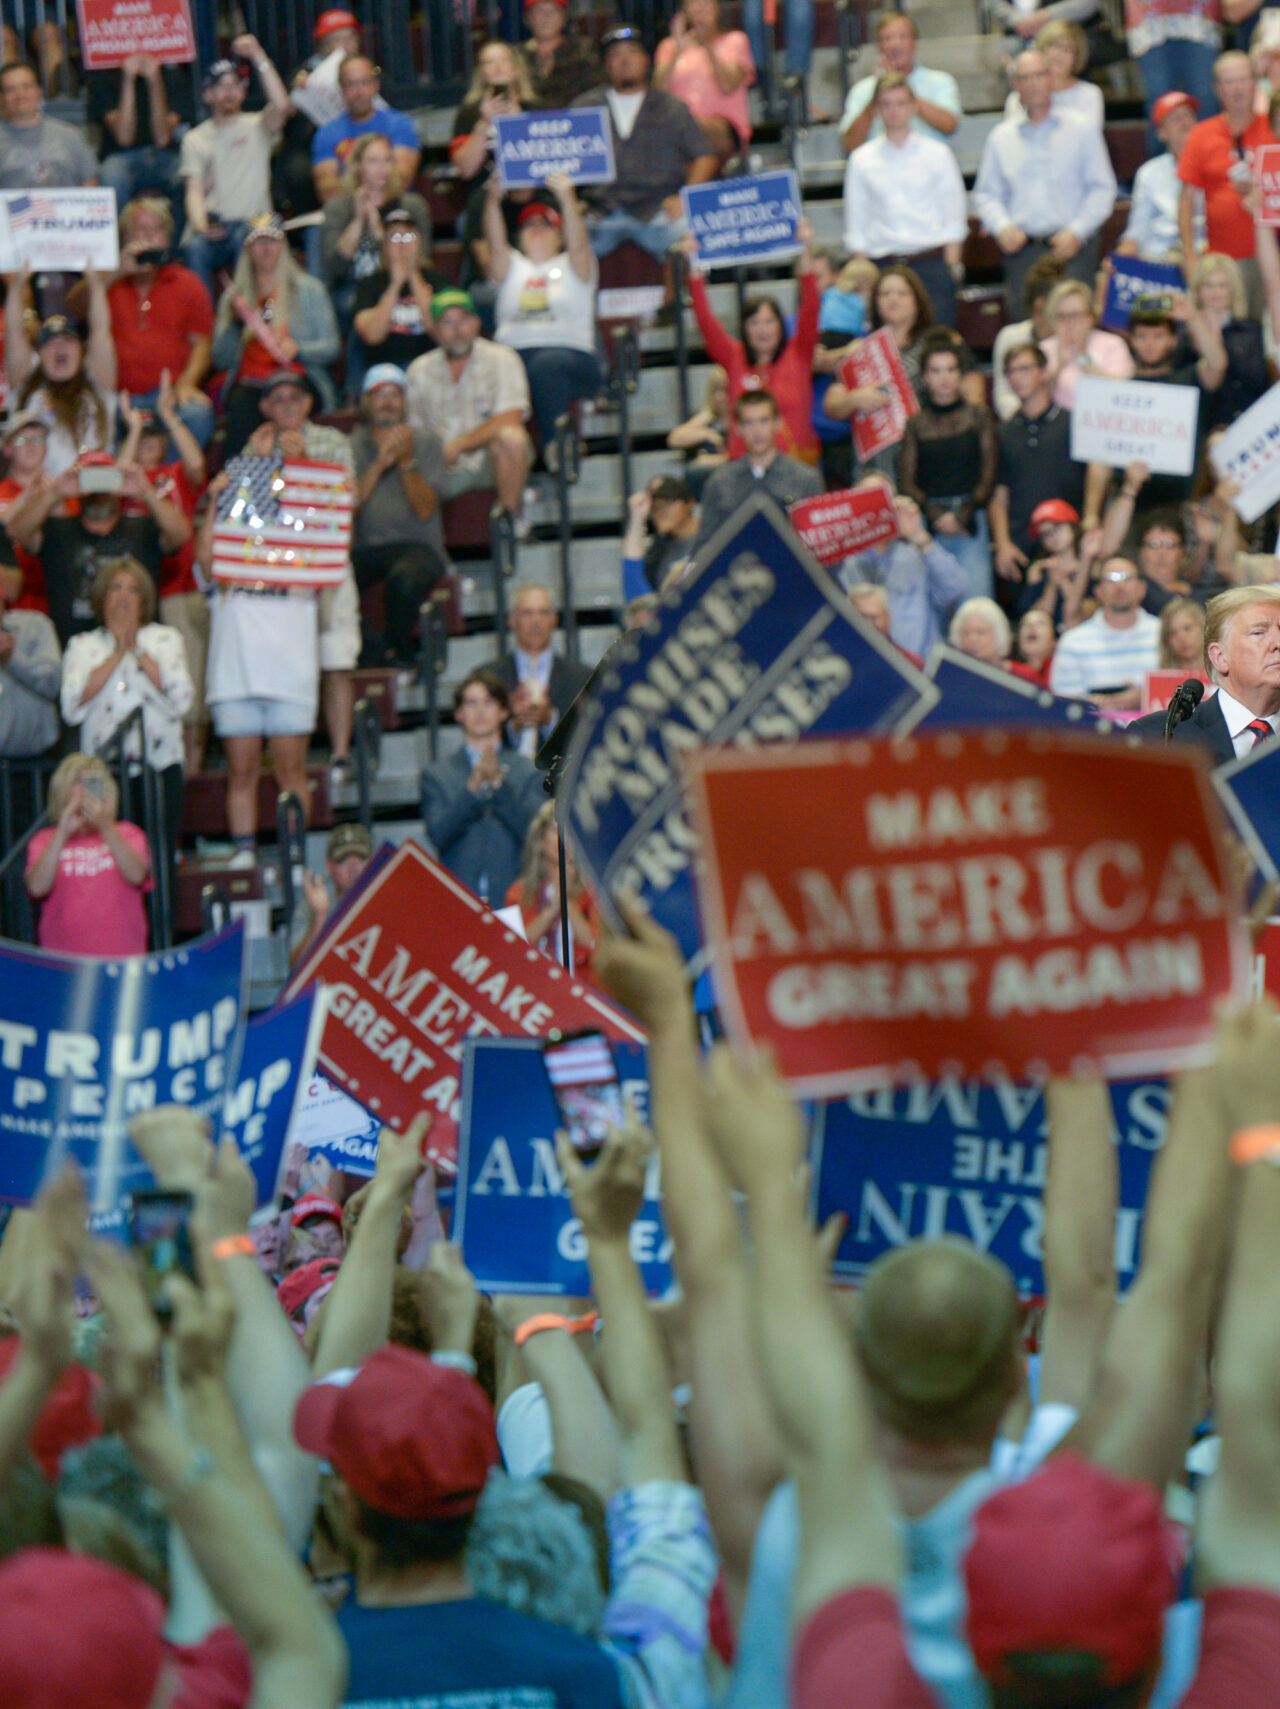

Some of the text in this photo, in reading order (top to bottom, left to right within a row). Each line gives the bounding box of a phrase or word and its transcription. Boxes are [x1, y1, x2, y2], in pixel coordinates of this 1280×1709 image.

[87, 13, 188, 36] AMERICA
[503, 135, 607, 161] AMERICA
[528, 119, 573, 138] KEEP
[692, 199, 798, 233] AMERICA
[1081, 409, 1188, 440] AMERICA
[865, 776, 1051, 851] MAKE
[730, 838, 1224, 963] AMERICA
[451, 945, 554, 1036] MAKE
[766, 959, 977, 1029] GREAT
[988, 931, 1207, 1019] AGAIN
[0, 995, 237, 1080] TRUMP
[327, 981, 436, 1083] GREAT
[13, 1054, 226, 1117] PENCE
[331, 1138, 379, 1162] AGAI
